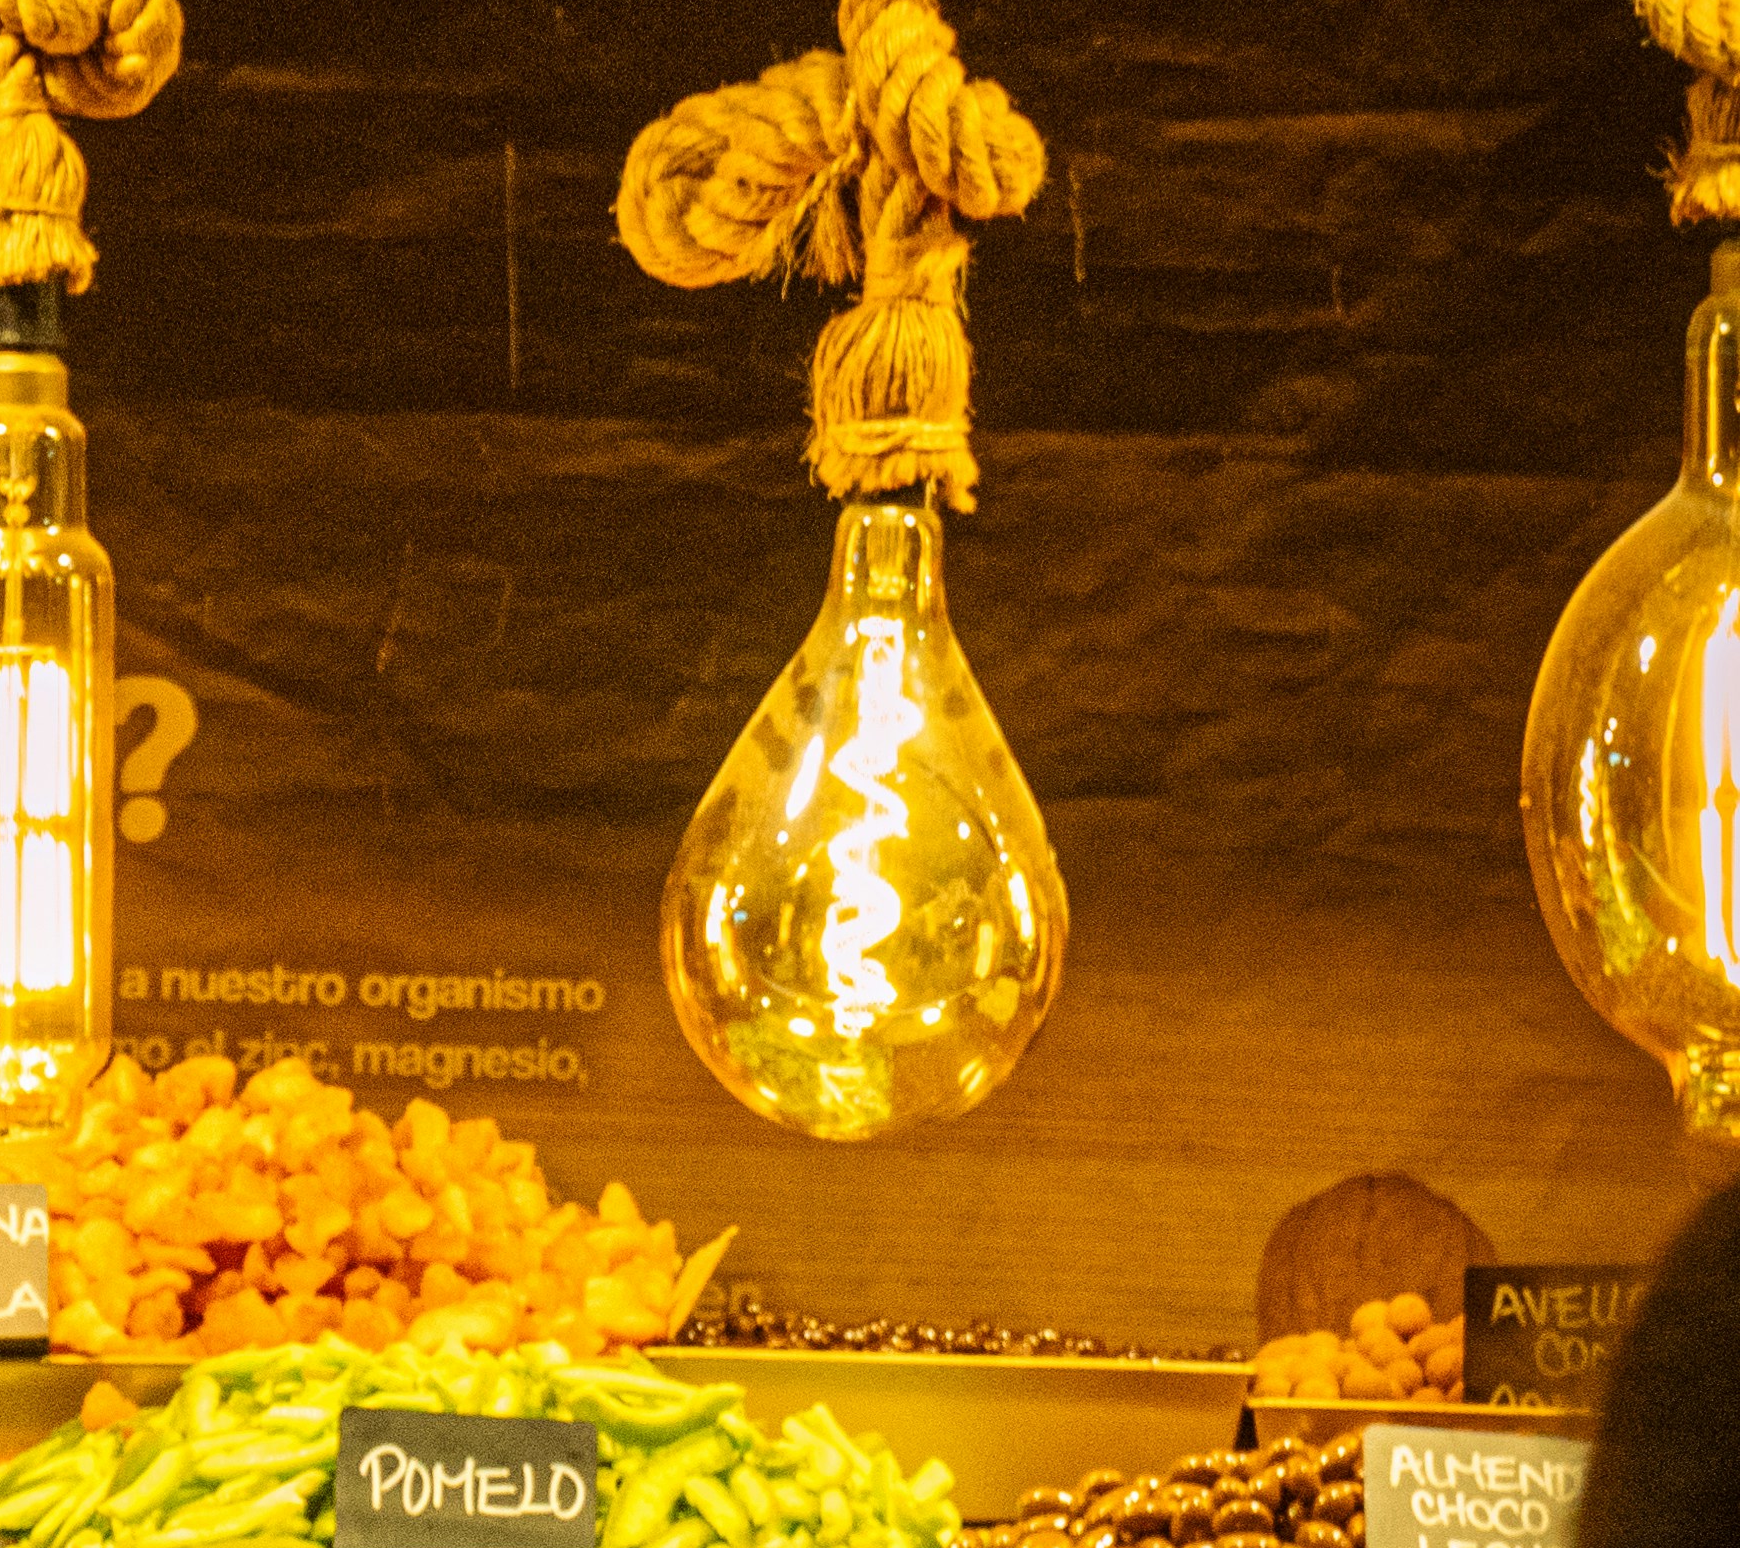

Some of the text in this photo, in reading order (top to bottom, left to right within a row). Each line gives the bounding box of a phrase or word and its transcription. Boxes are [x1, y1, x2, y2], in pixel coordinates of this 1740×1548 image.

[119, 967, 150, 1000] a
[160, 963, 347, 1007] nuestro
[359, 966, 607, 1020] organismo
[353, 1035, 590, 1089] magnesio,
[359, 1442, 587, 1521] POMELO
[1389, 1443, 1583, 1503] ALMEND
[1411, 1489, 1550, 1537] CHOCO
